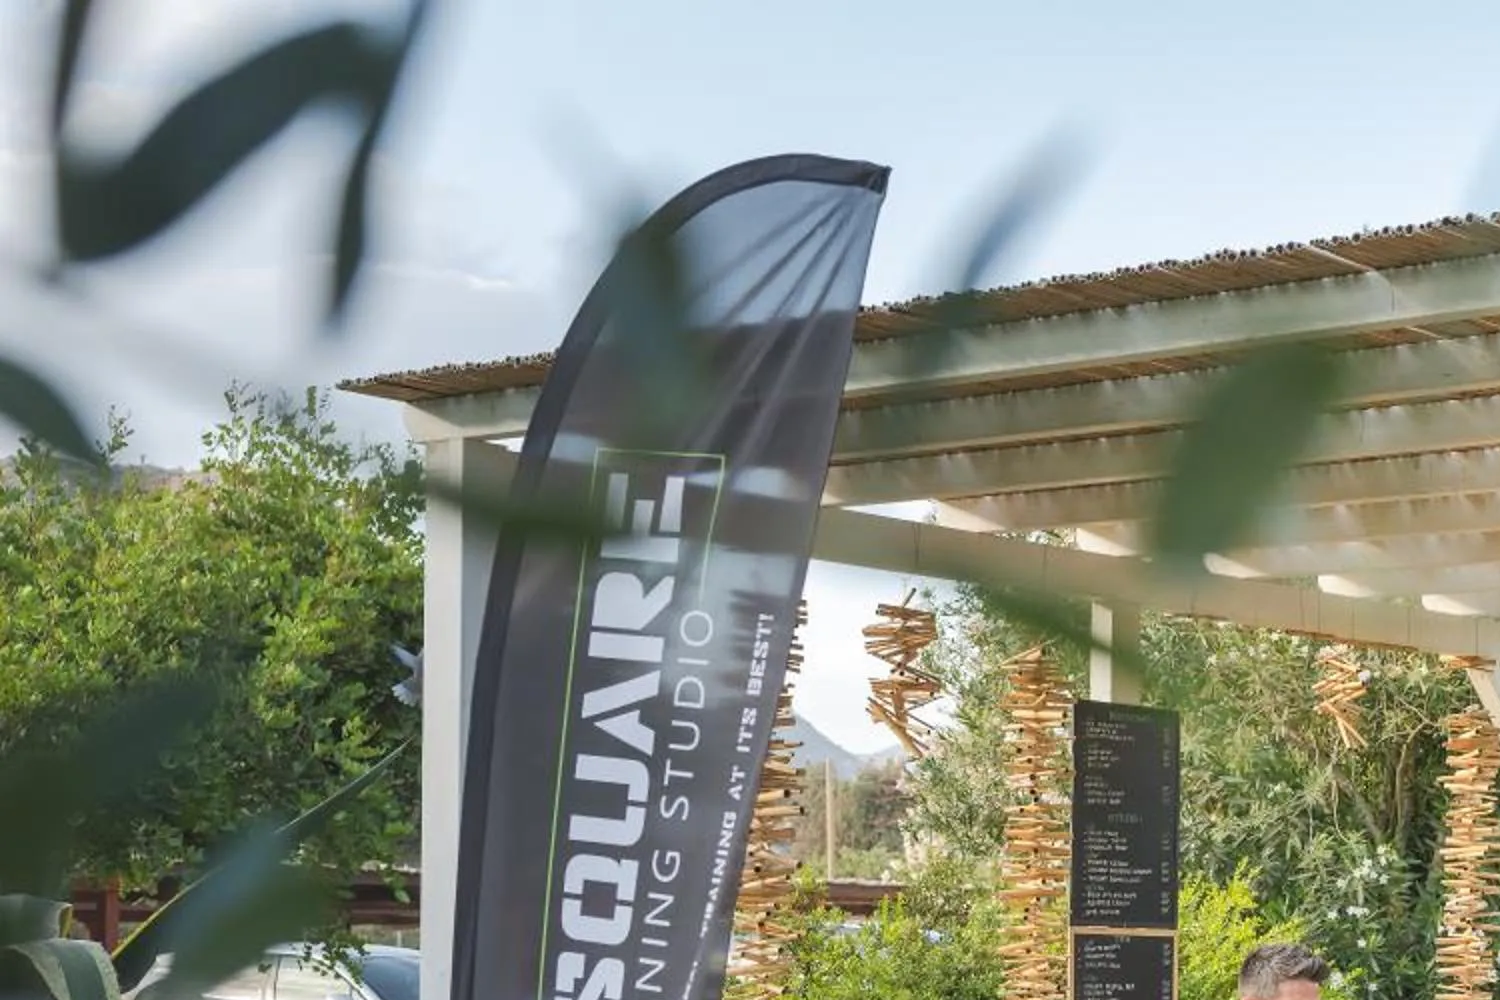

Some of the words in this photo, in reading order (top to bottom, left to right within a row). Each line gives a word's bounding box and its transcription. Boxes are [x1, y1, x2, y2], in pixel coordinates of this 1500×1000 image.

[660, 610, 713, 821] STUDIO
[728, 765, 746, 800] AT
[746, 613, 774, 697] BEST!
